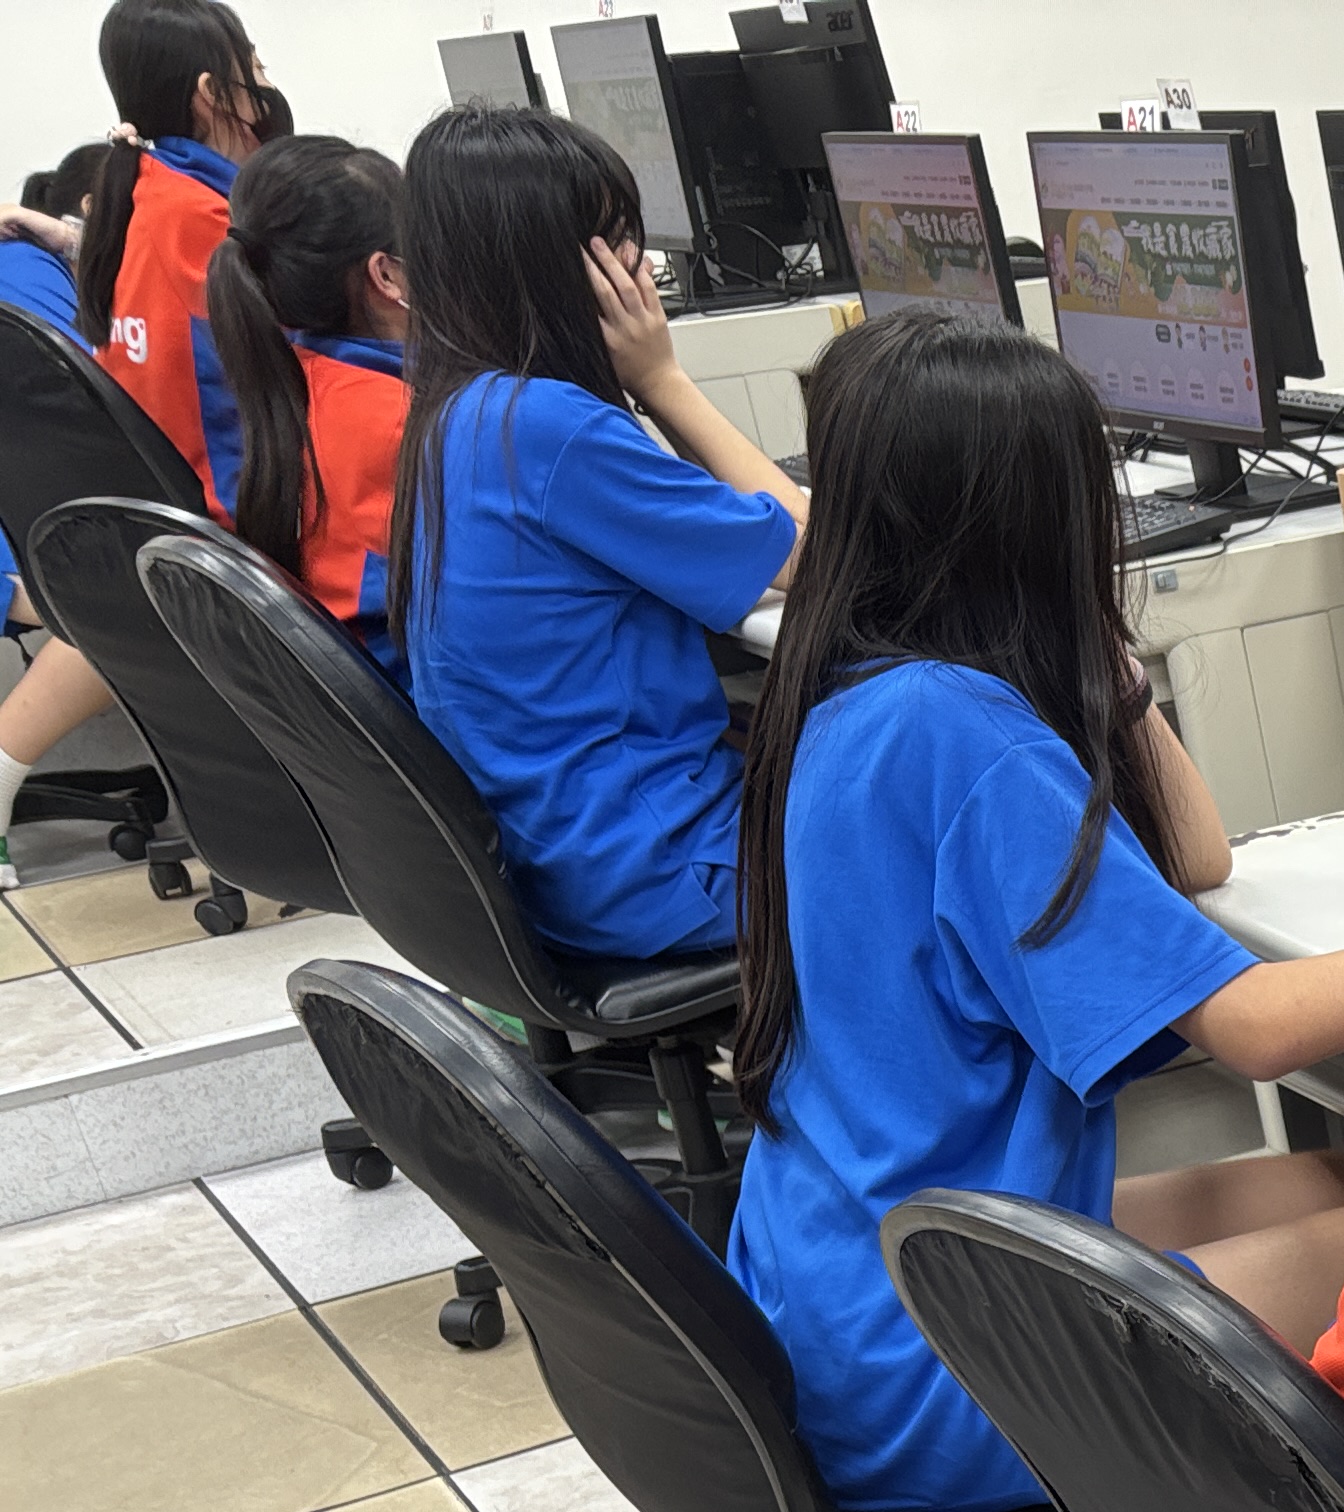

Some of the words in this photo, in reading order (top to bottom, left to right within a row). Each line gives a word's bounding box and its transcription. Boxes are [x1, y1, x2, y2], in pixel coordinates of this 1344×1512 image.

[1165, 87, 1192, 110] A30
[896, 111, 918, 132] A22
[1127, 106, 1155, 132] A21
